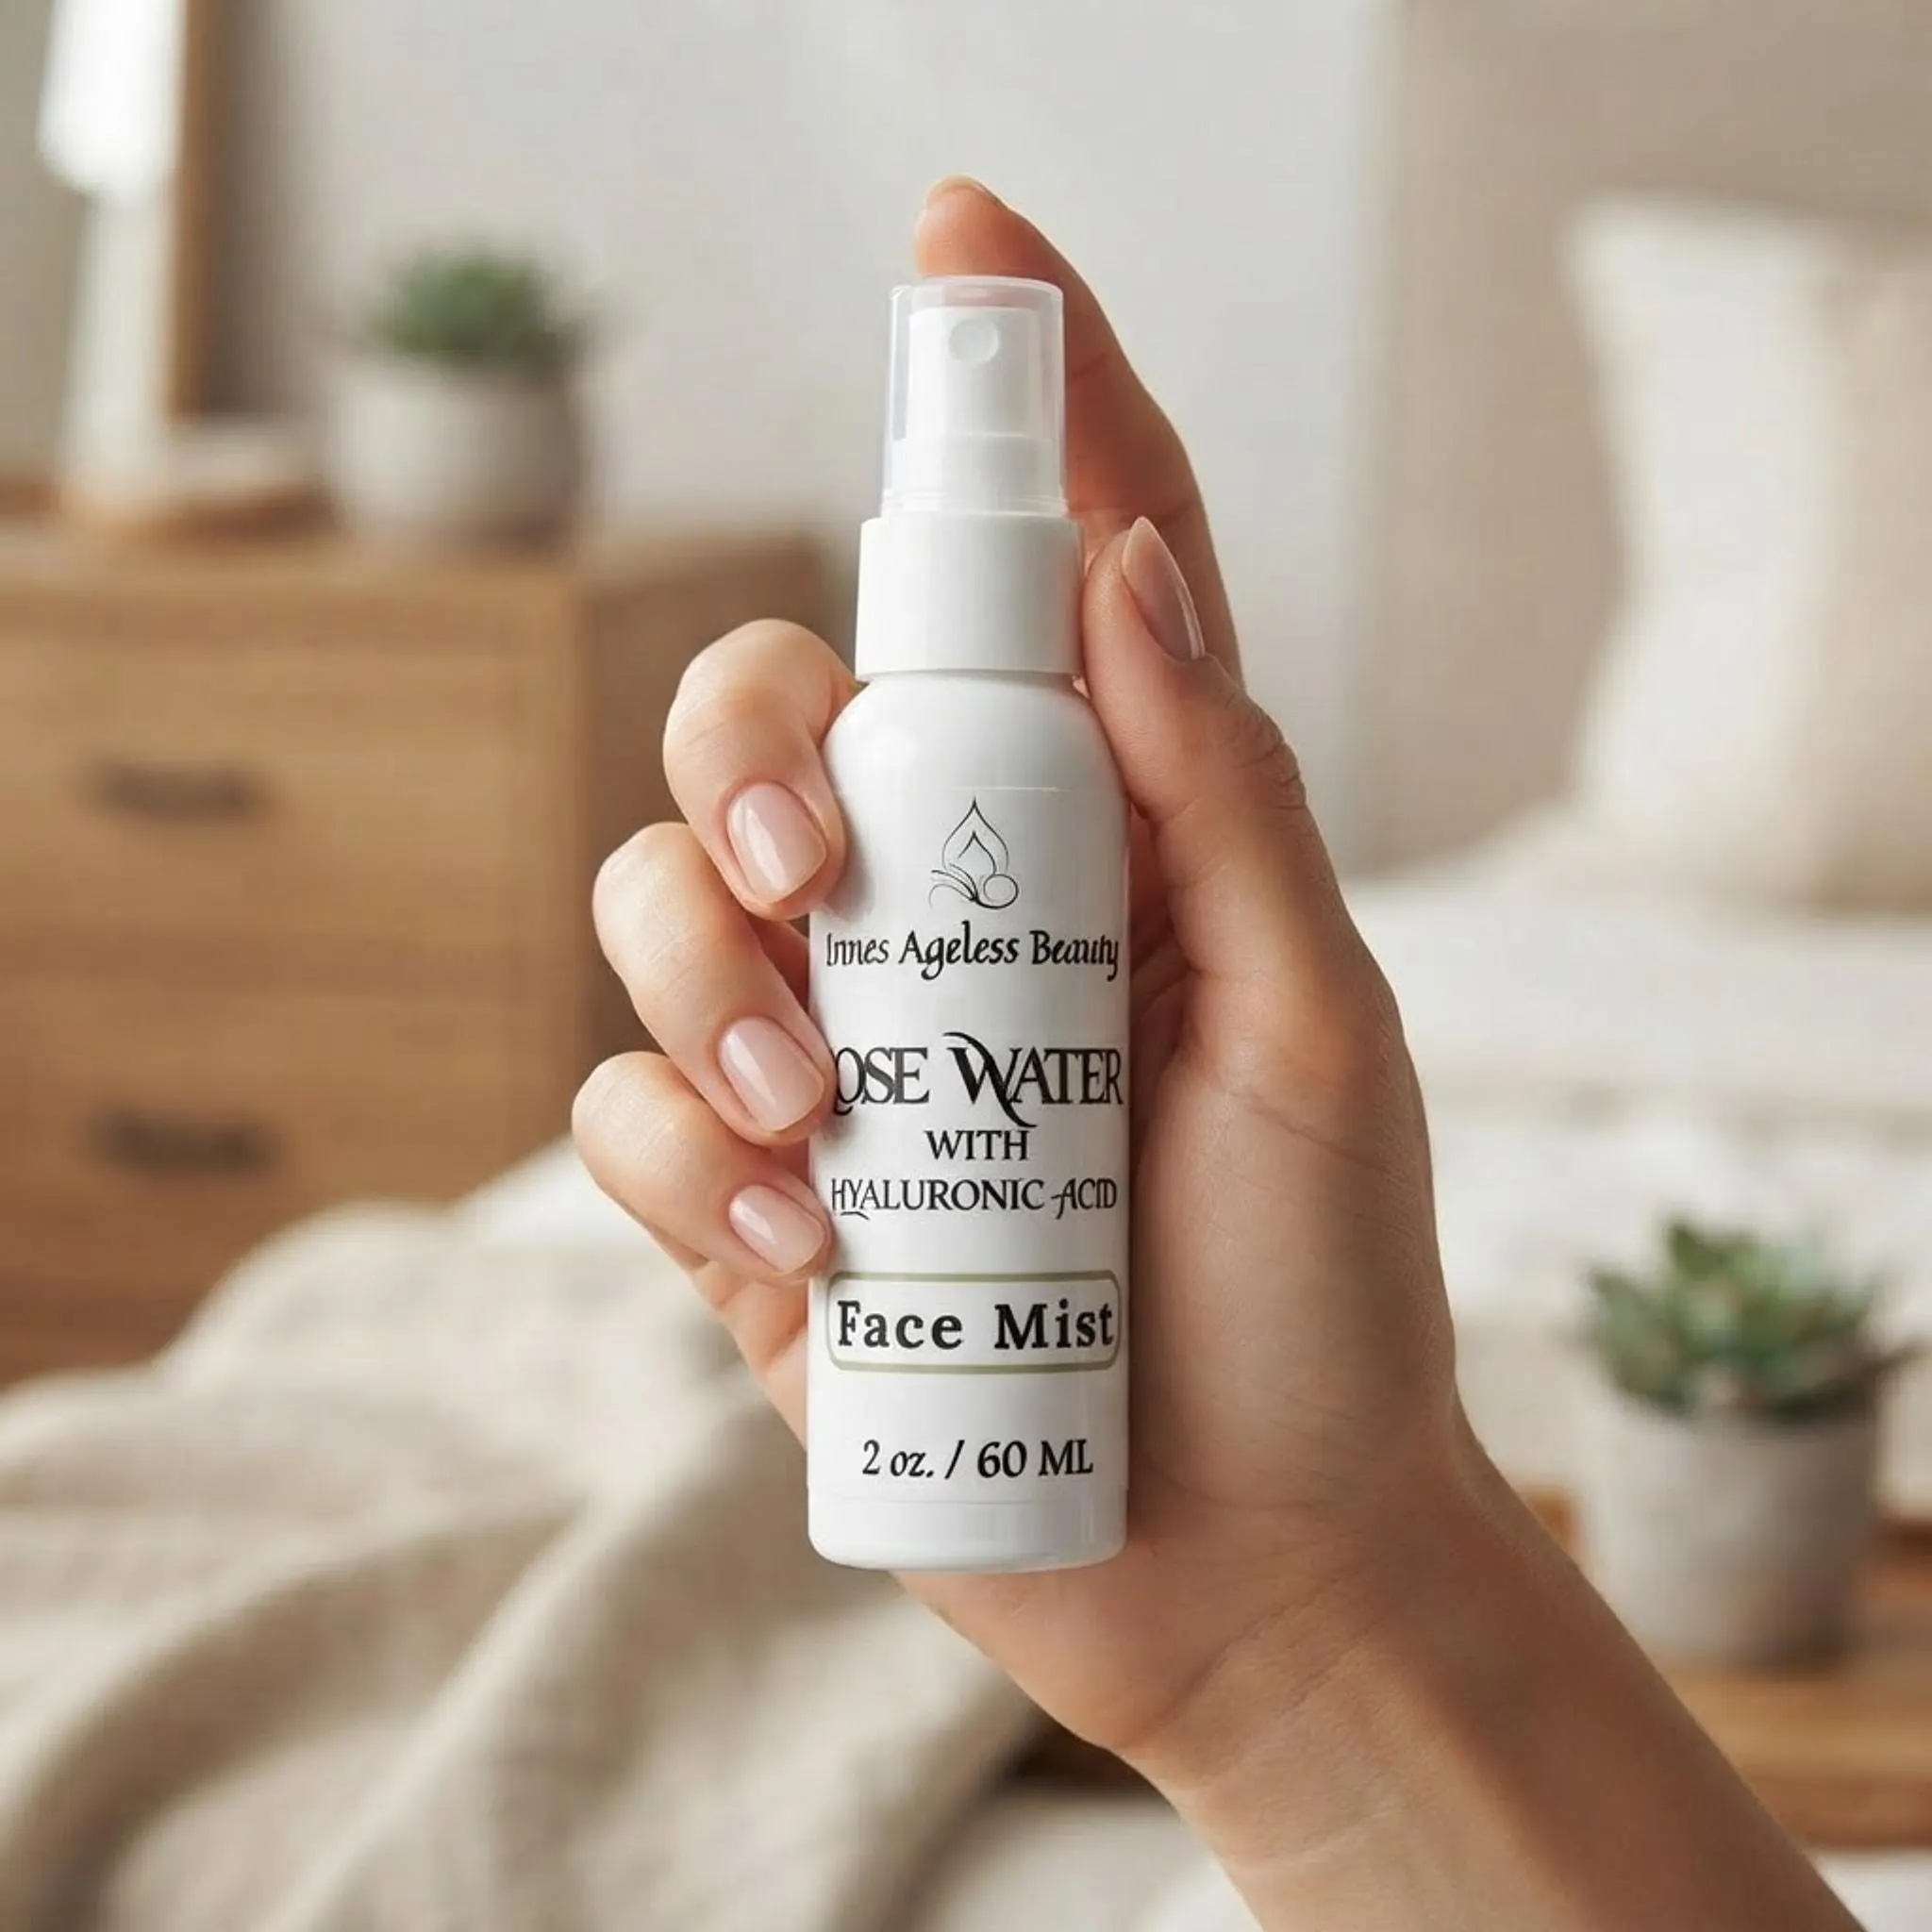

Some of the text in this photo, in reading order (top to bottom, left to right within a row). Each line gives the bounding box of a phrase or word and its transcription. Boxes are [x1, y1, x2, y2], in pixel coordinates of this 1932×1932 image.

[898, 920, 1020, 981] Ageless
[1030, 930, 1119, 982] Beauty
[833, 1031, 1124, 1128] OSE WATER
[924, 1129, 1031, 1161] WITH
[831, 1177, 1117, 1220] HYALURONIC ACID
[837, 1298, 1114, 1350] Face Mist
[861, 1439, 1094, 1479] 2 oz. / 60 ML
